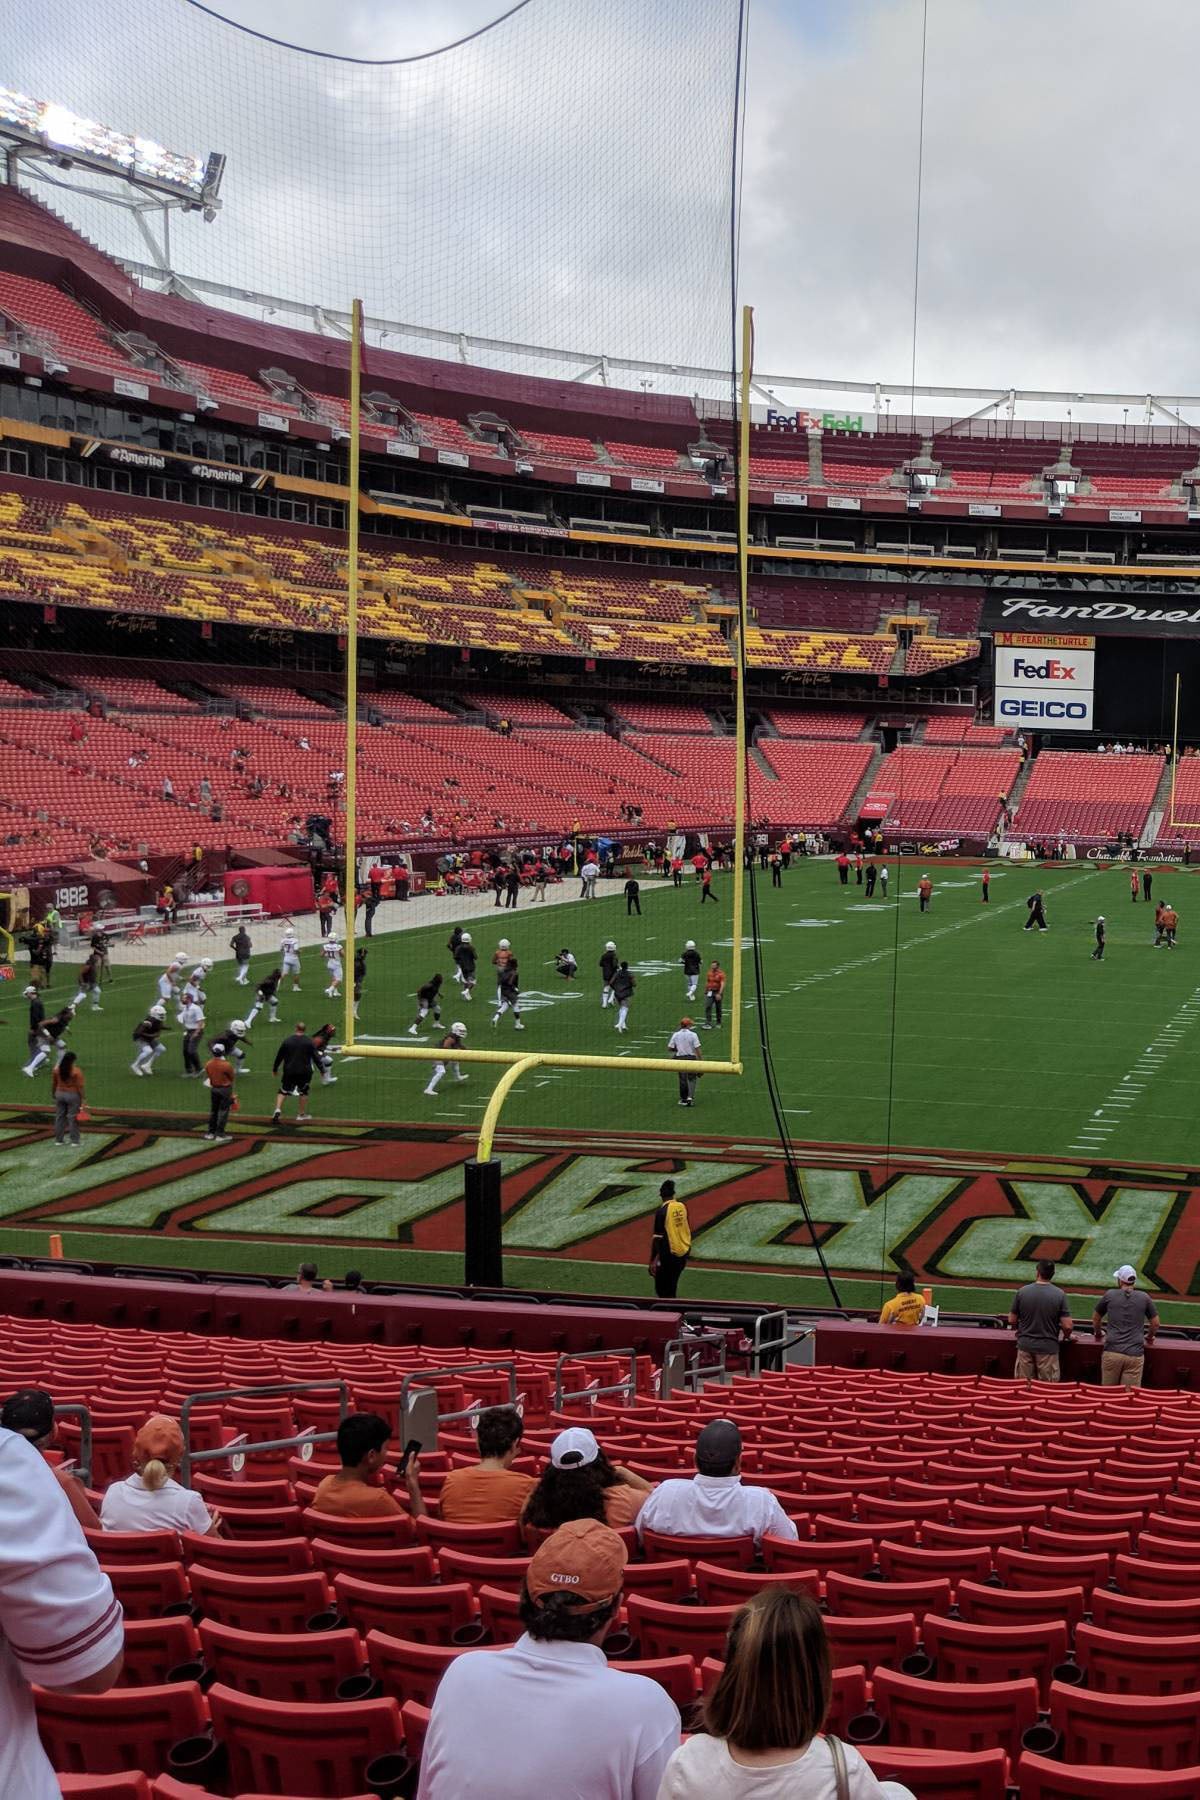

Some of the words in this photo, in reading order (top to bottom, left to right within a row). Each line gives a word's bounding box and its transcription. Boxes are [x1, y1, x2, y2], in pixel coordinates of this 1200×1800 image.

[767, 409, 863, 431] FedExField
[119, 448, 166, 469] Ameritel
[200, 466, 243, 483] Ameritel
[1016, 635, 1088, 646] #FEARTHETURTLE
[1014, 658, 1075, 680] FedEx
[1000, 699, 1087, 719] GEICO
[1137, 850, 1183, 862] Foundation
[55, 885, 89, 909] 1982
[550, 1572, 580, 1584] GTBO
